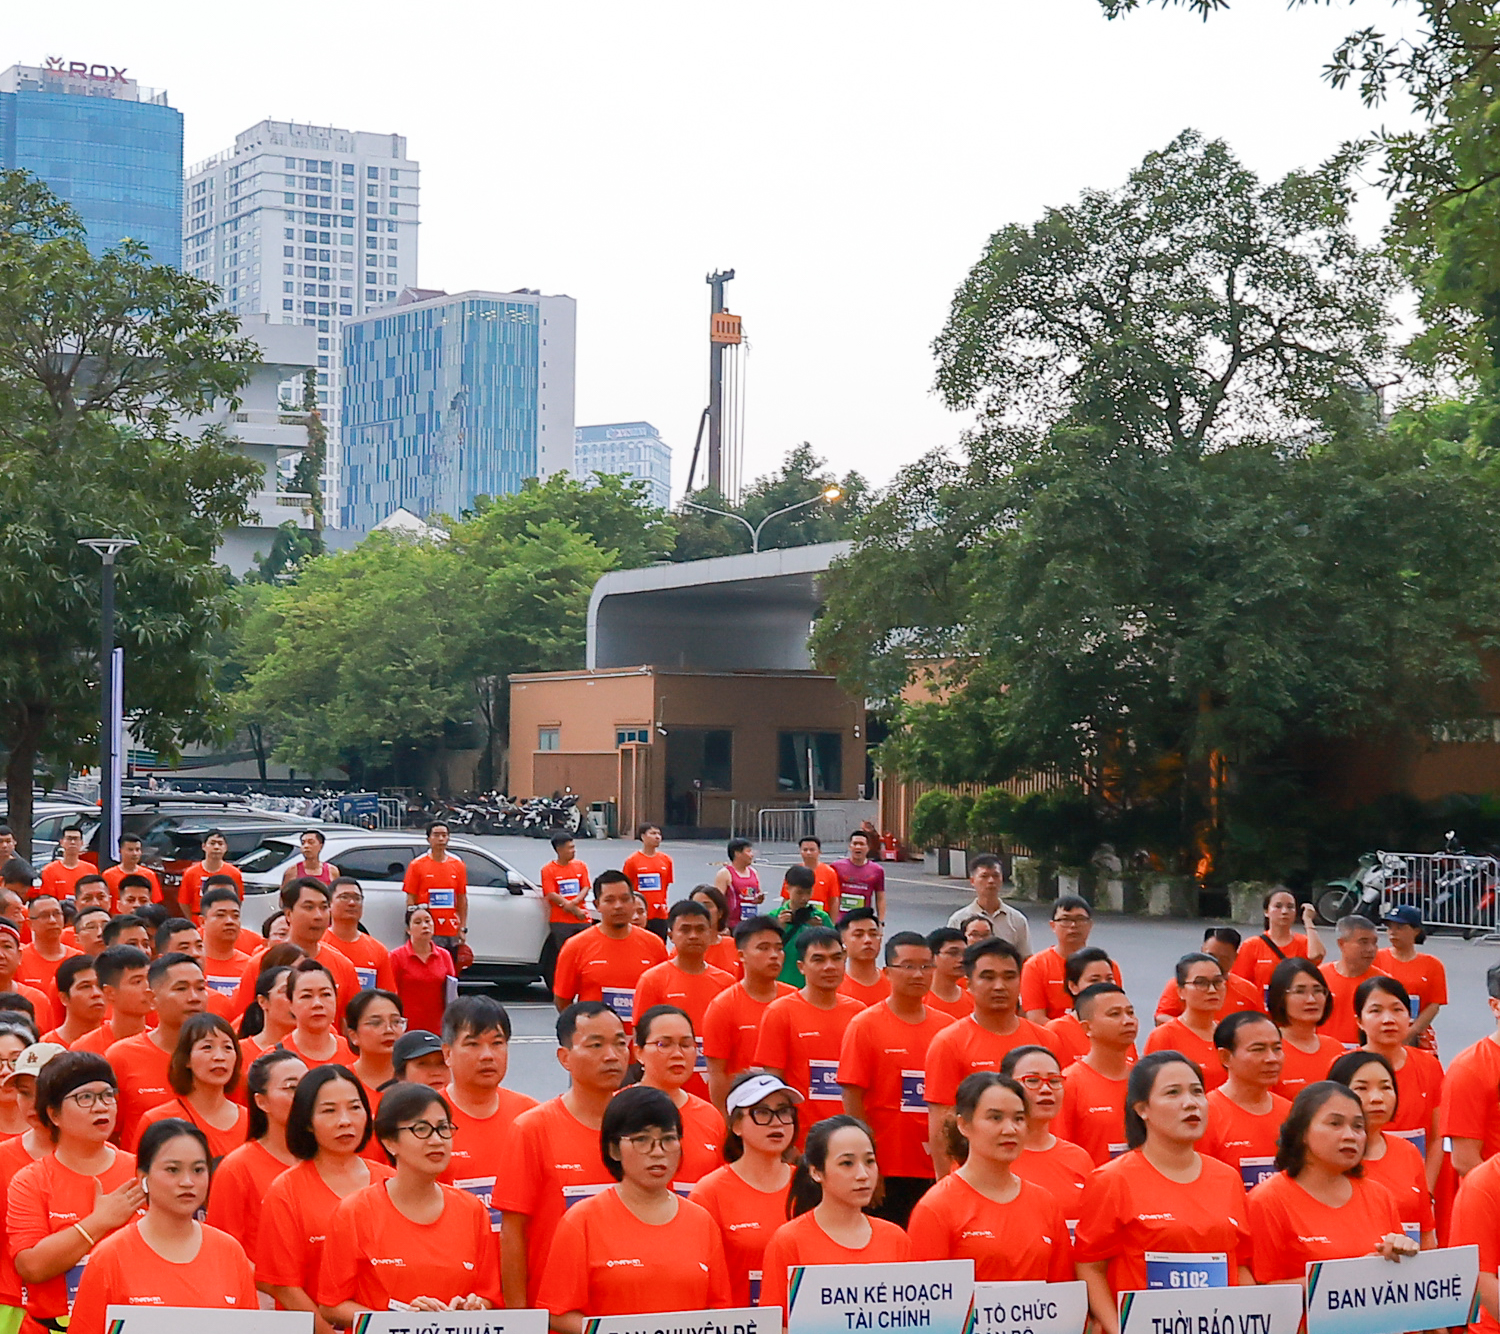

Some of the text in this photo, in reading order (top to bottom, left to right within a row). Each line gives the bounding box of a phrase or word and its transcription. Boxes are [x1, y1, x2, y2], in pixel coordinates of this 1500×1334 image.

[68, 60, 129, 84] ROX
[1169, 1270, 1209, 1288] 6102
[821, 1286, 858, 1305] BAN
[893, 1283, 953, 1305] HOẠCH
[1328, 1273, 1462, 1310] BAN VĂN NGHỆ
[845, 1305, 931, 1329] TÀI CHÍNH
[1011, 1301, 1058, 1323] CHỨC
